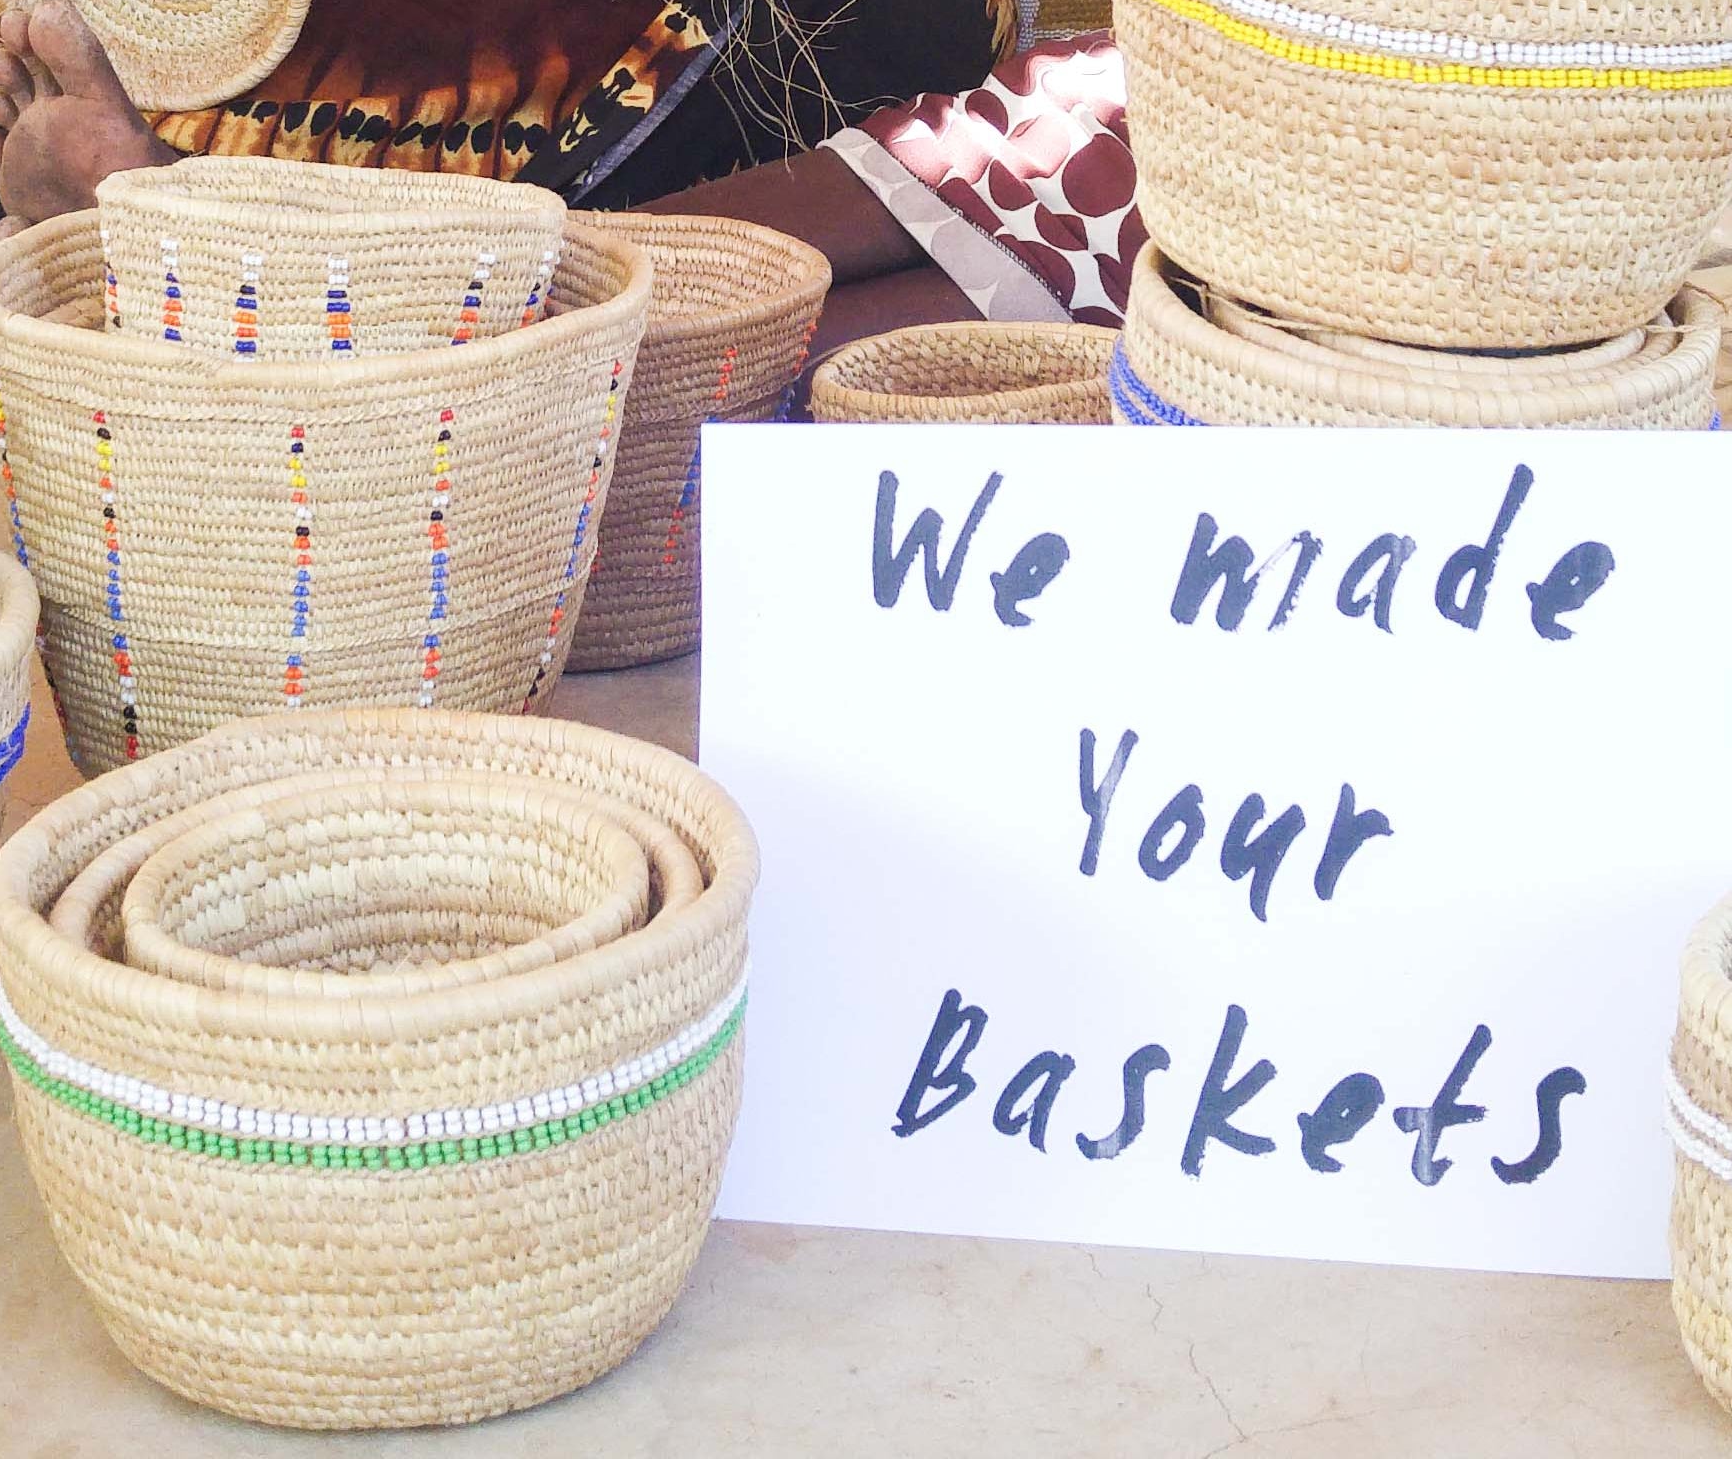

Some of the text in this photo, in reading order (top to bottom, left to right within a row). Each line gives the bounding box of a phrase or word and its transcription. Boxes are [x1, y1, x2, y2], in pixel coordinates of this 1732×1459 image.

[870, 463, 1615, 642] We made
[1076, 726, 1395, 923] Your
[890, 988, 1588, 1188] Baskets
